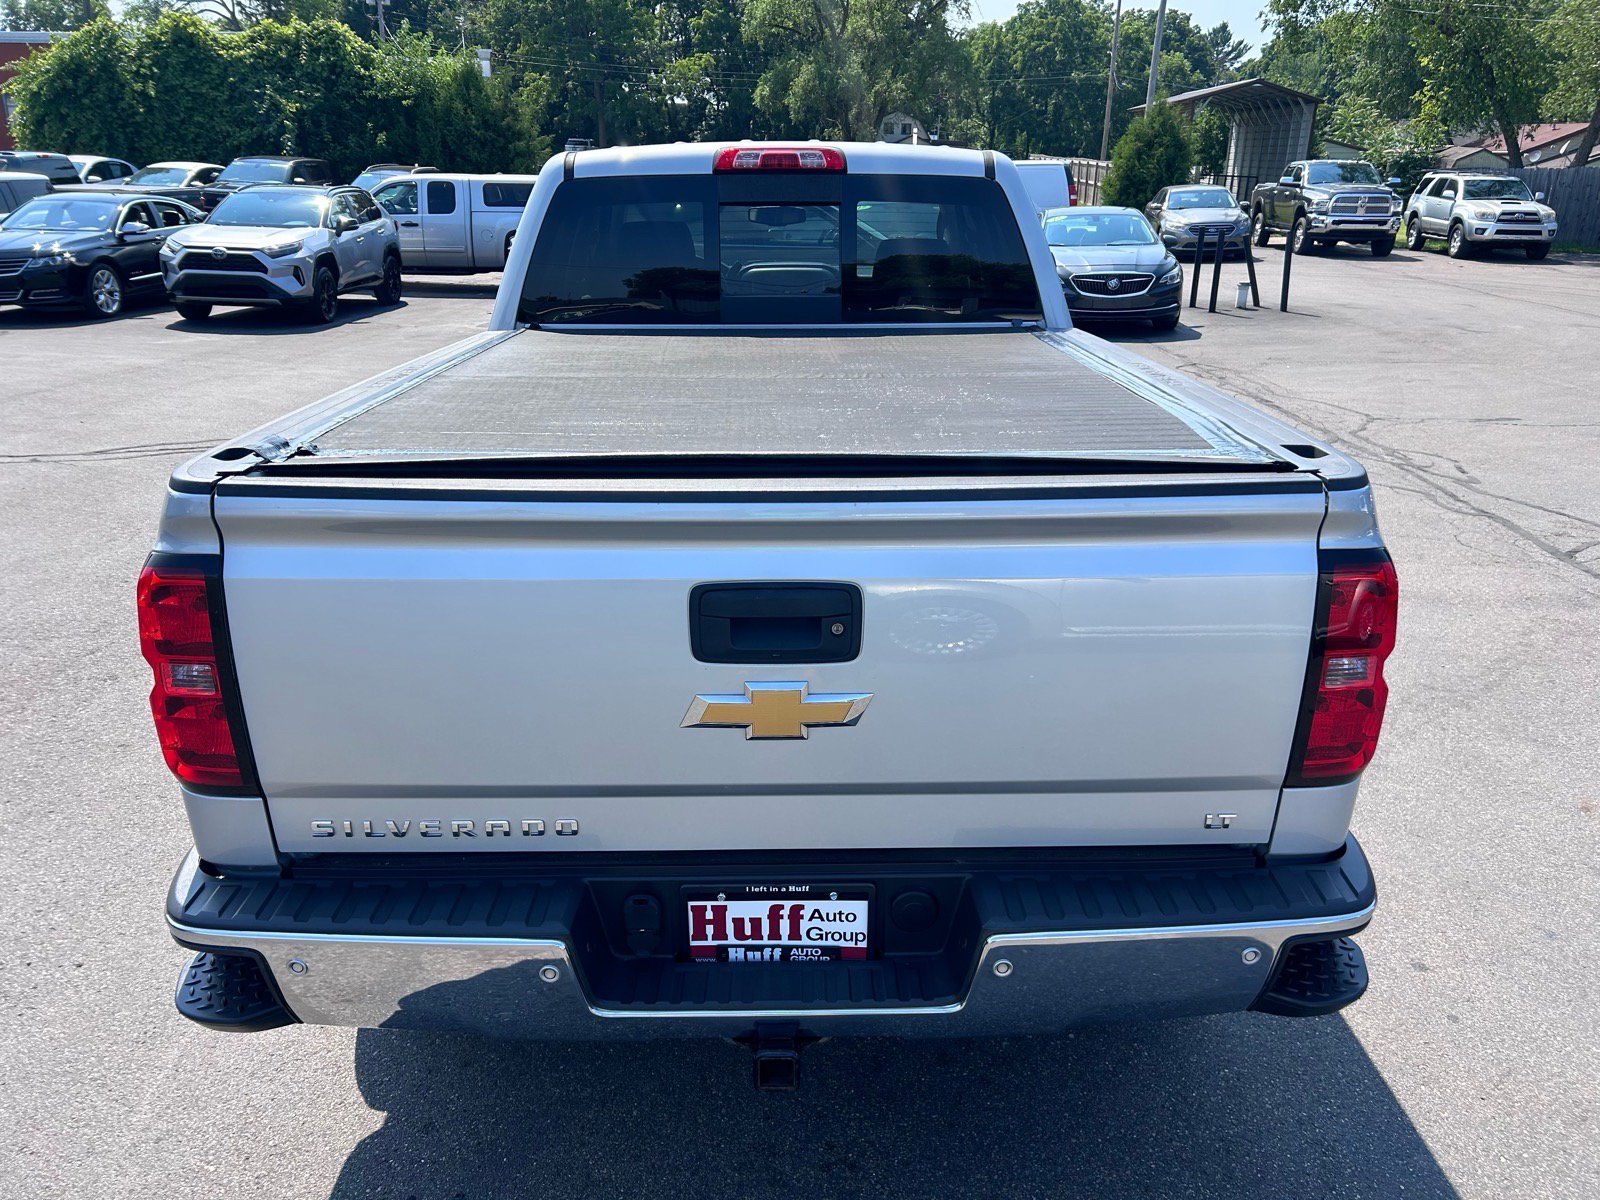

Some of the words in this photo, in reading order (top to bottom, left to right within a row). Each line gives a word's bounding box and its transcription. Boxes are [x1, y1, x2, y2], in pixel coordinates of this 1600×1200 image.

[310, 819, 580, 838] SILVERADO
[1204, 813, 1237, 829] LT
[690, 904, 805, 942] Huff
[807, 908, 857, 923] Auto
[805, 926, 867, 945] Group
[728, 947, 782, 962] Huff
[790, 948, 822, 956] AUTO
